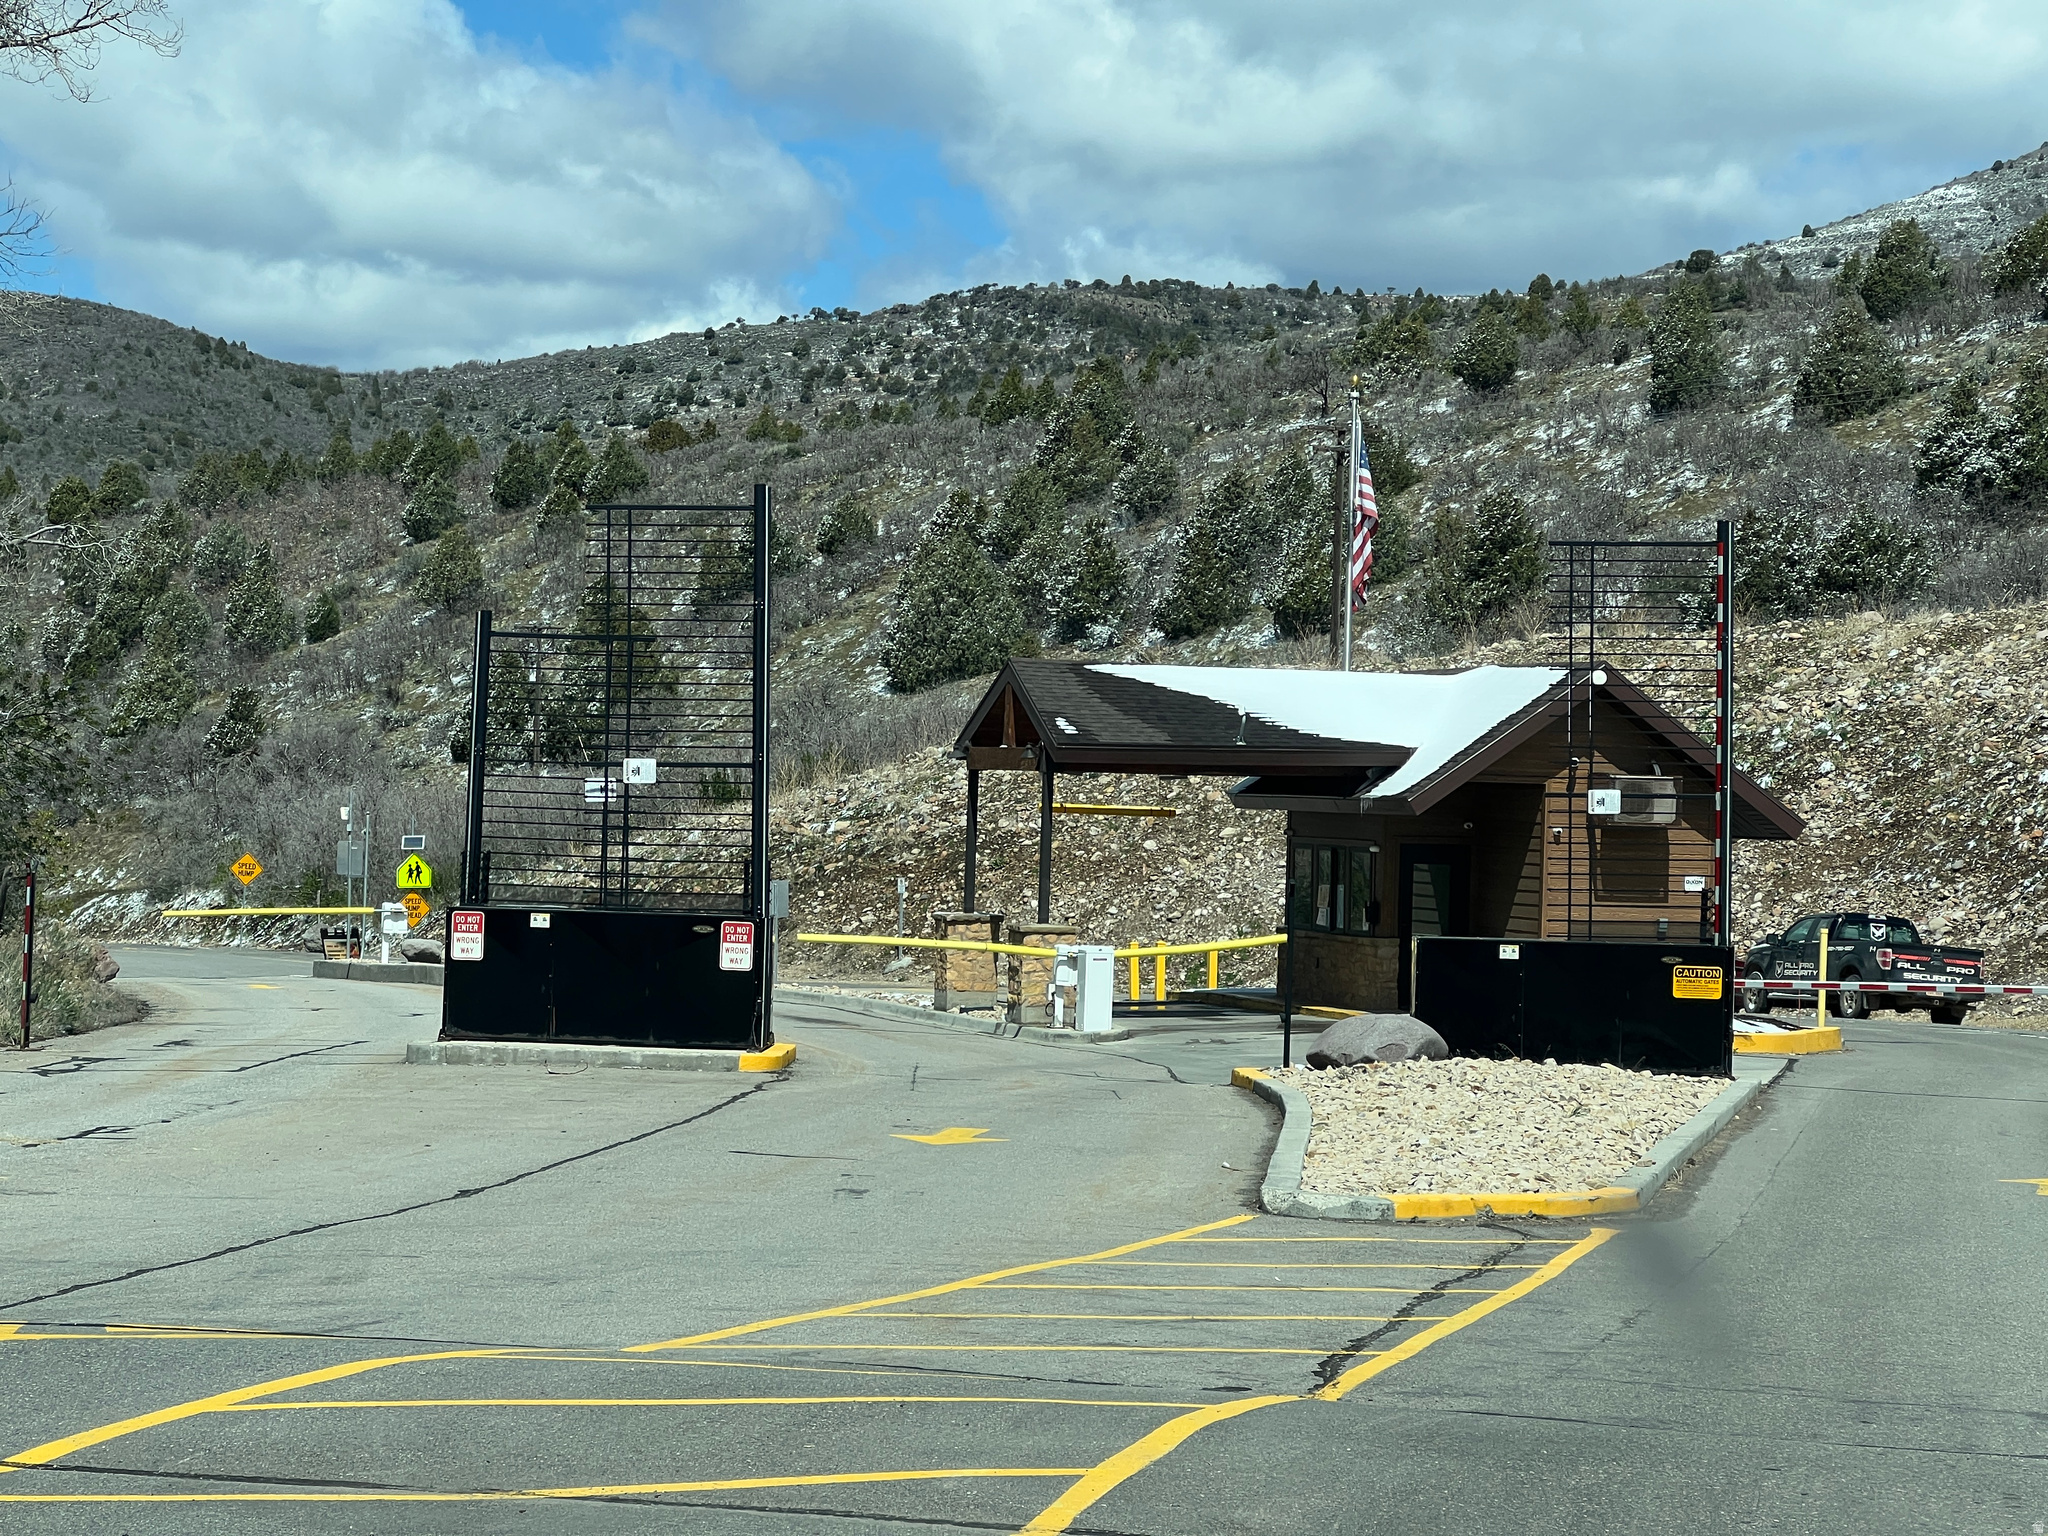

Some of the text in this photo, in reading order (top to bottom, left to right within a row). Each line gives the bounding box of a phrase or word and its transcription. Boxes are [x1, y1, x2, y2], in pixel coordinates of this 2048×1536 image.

[456, 915, 465, 923] DO
[736, 926, 749, 934] NOT
[456, 936, 479, 944] WRONG
[727, 934, 748, 942] ENTER
[1897, 962, 1925, 970] ALL
[1946, 966, 1975, 974] PRO
[1676, 968, 1719, 978] CAUTION
[1903, 972, 1963, 983] SECURITY
